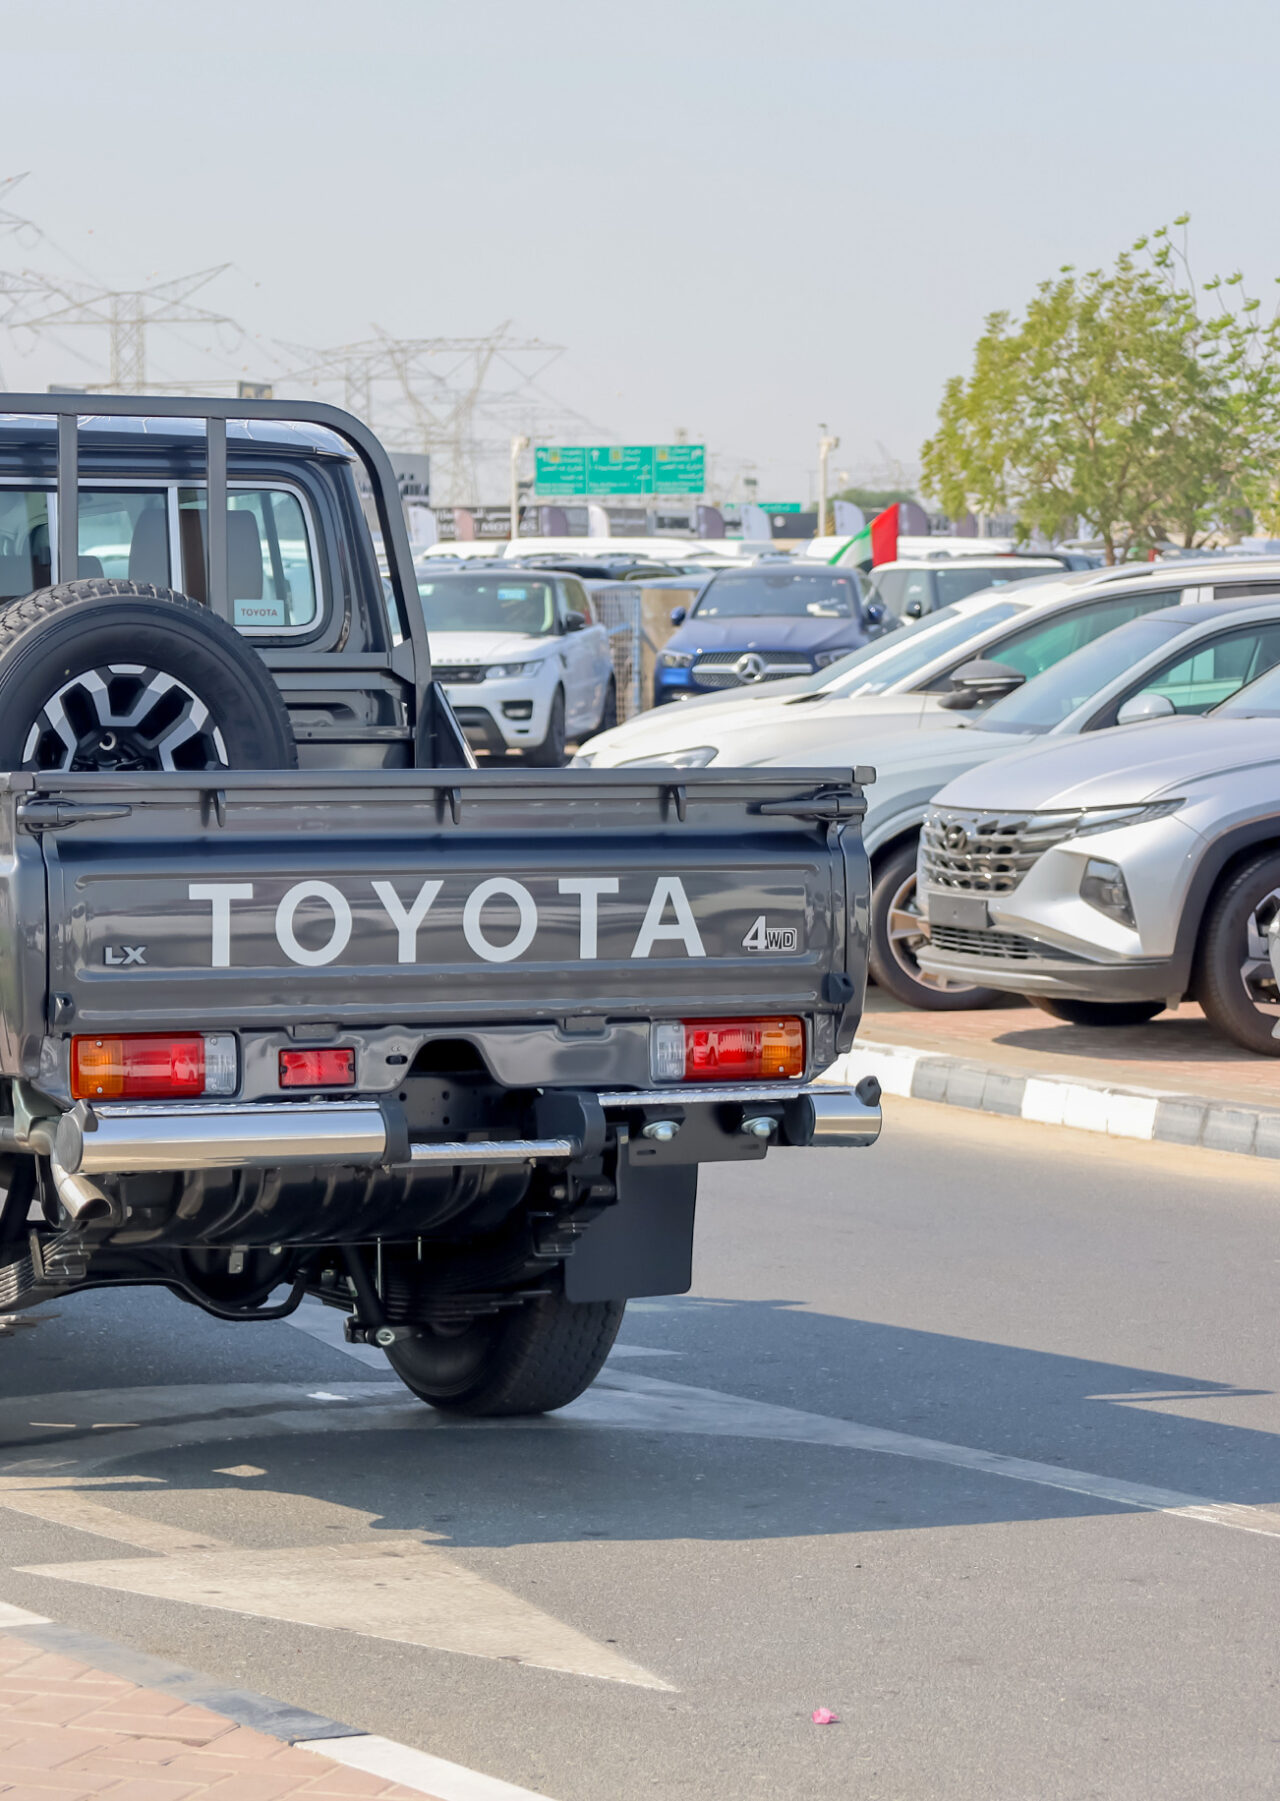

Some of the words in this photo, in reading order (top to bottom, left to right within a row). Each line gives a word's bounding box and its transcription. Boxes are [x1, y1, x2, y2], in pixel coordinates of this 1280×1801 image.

[241, 608, 278, 617] TOYOTA
[188, 876, 707, 967] TOYOTA
[741, 915, 798, 952] 4WD
[104, 945, 148, 965] LX
